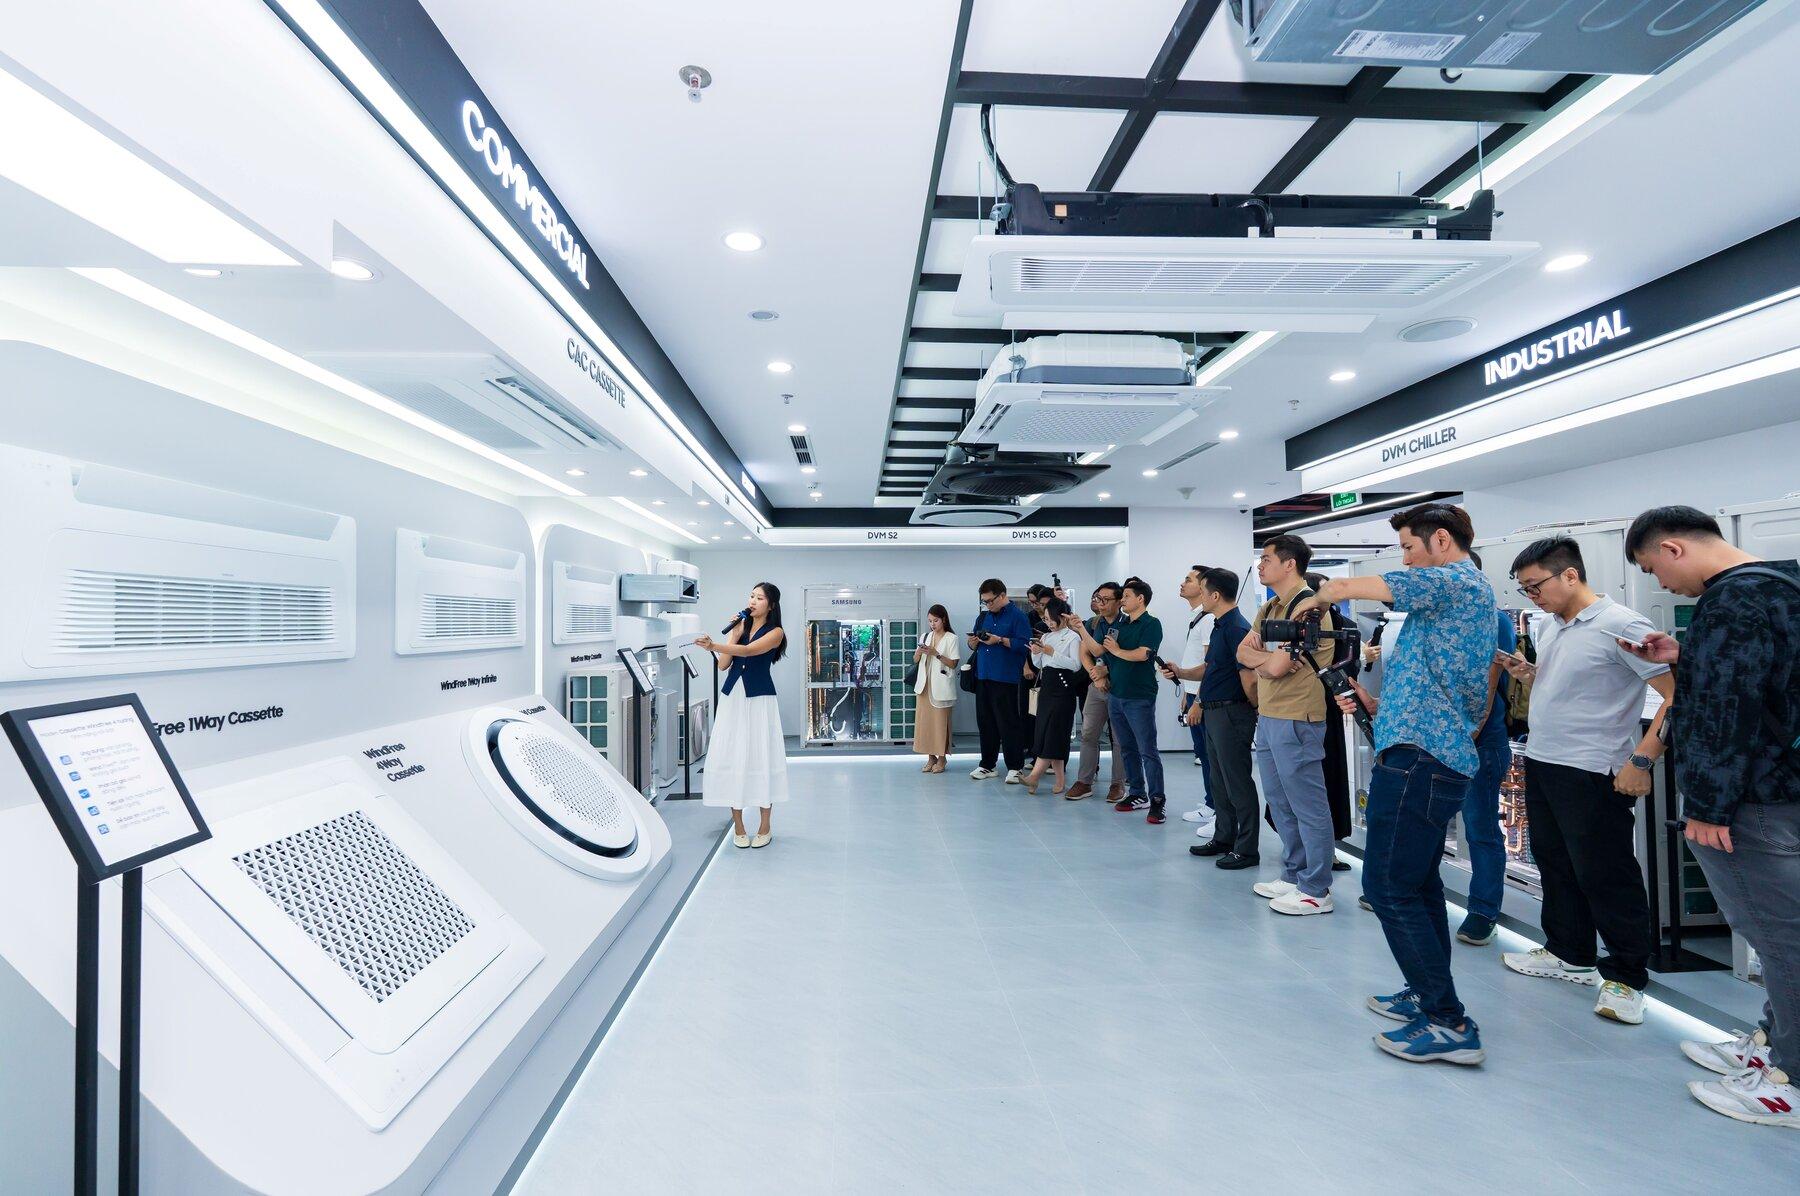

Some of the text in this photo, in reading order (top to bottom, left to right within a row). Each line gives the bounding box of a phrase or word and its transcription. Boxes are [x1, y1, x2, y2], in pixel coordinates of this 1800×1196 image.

[462, 99, 590, 290] COMMERCIAL
[1484, 309, 1631, 386] INDUSTRIAL
[567, 338, 626, 408] CAC CASSETTE
[1382, 426, 1457, 463] DVM CHILLER
[867, 531, 898, 540] DVM S2
[1012, 530, 1057, 539] DVM S ECO
[188, 715, 226, 732] 1Way
[227, 705, 284, 725] Cassette
[363, 743, 406, 759] WindFree
[386, 764, 426, 782] Cassette
